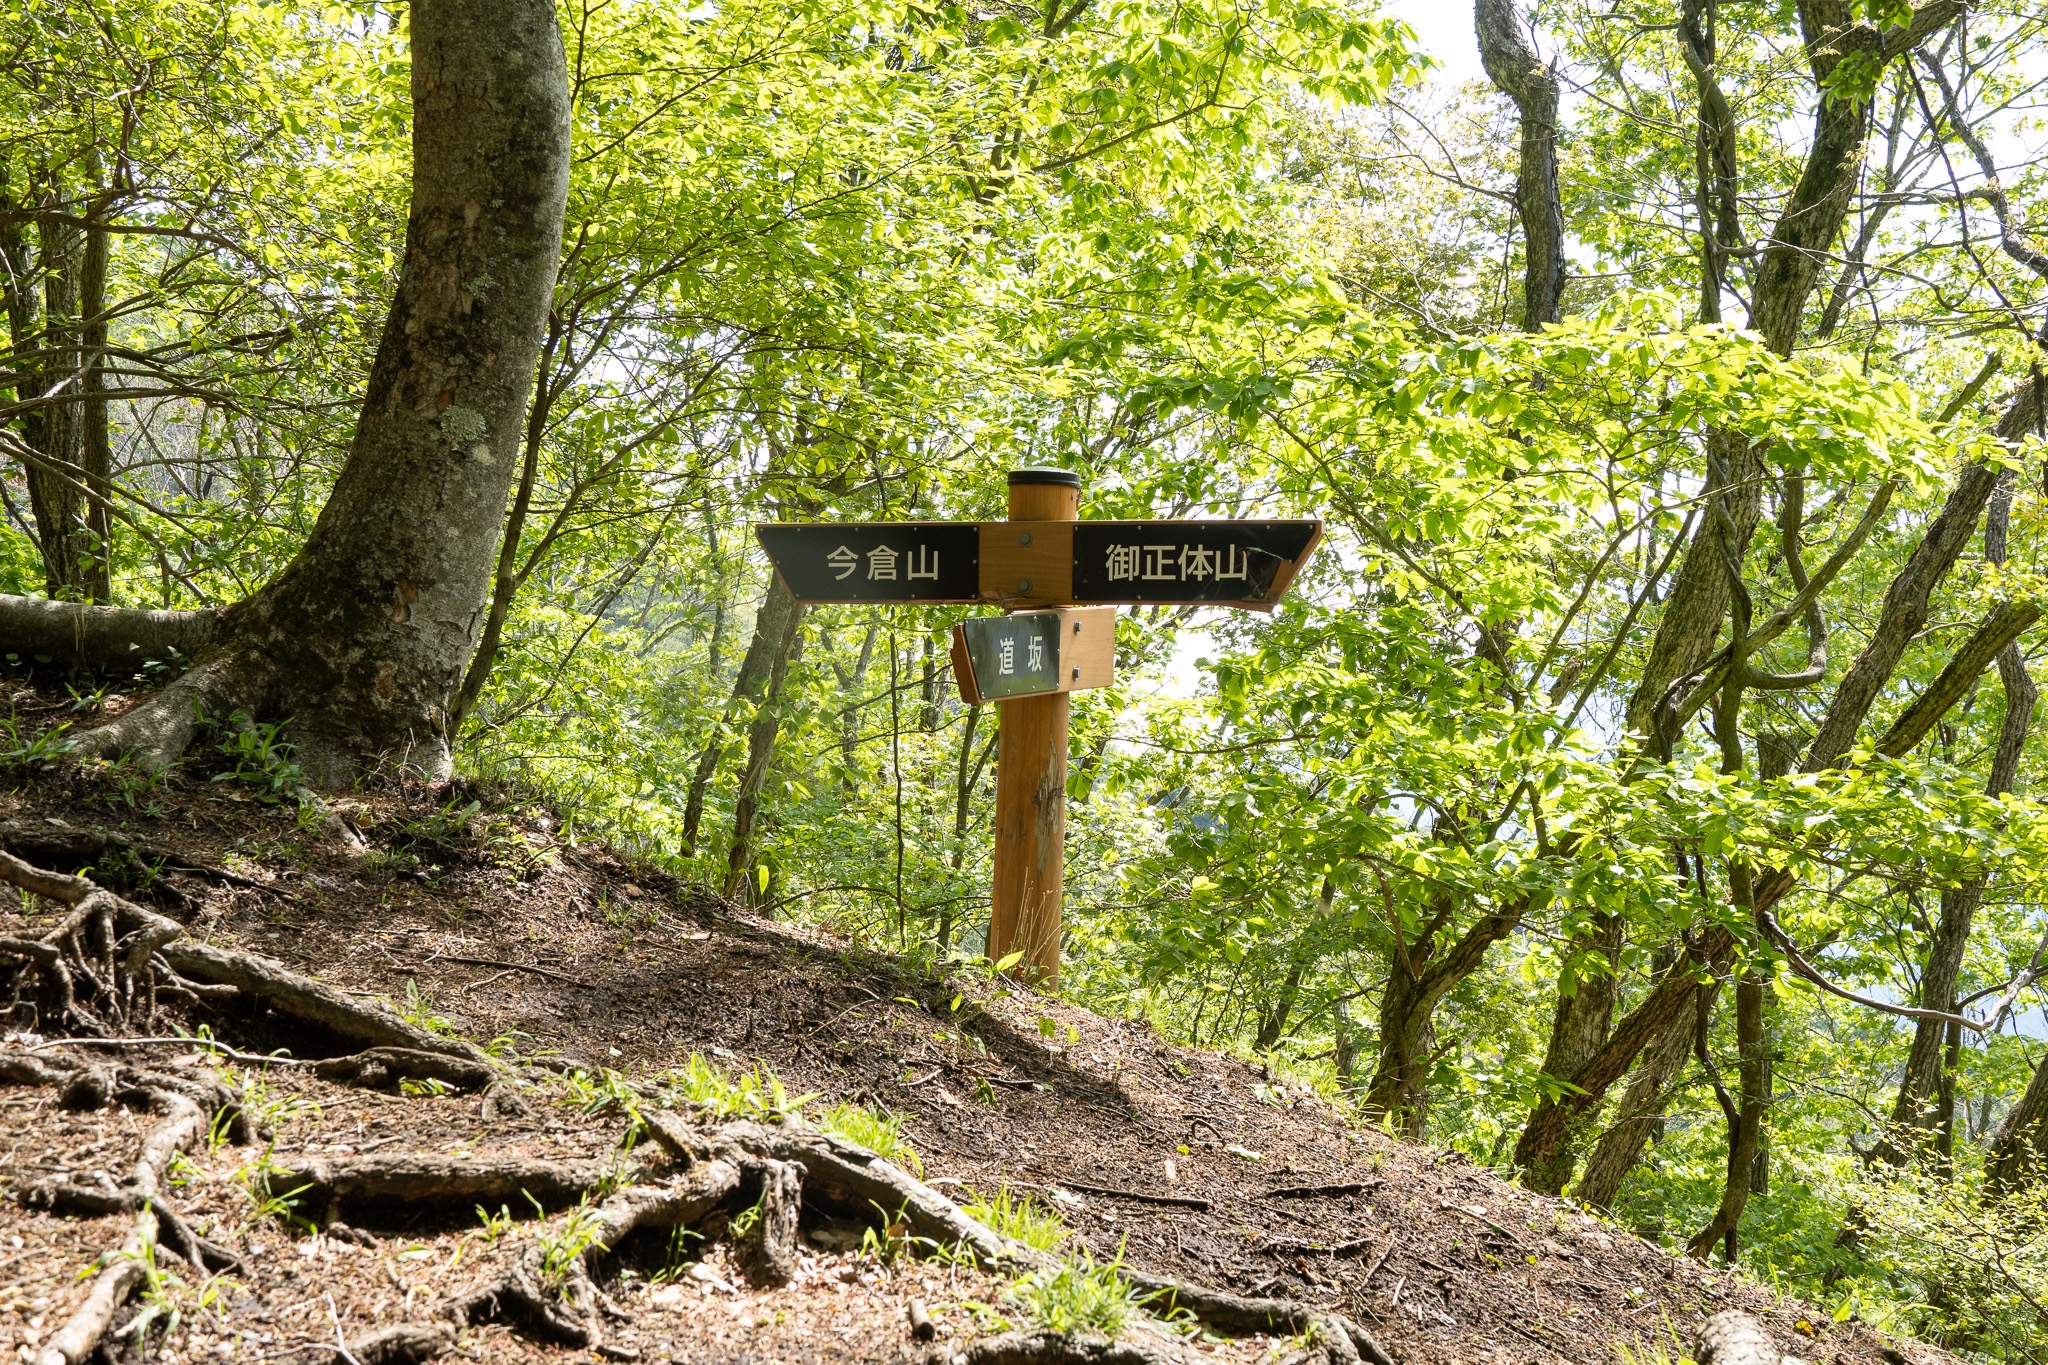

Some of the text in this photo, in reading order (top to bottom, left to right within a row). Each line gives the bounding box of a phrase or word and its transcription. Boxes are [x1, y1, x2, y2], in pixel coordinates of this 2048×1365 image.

[826, 544, 939, 581] 今倉山
[1105, 543, 1248, 581] 御正体山
[998, 635, 1044, 675] 道坂
